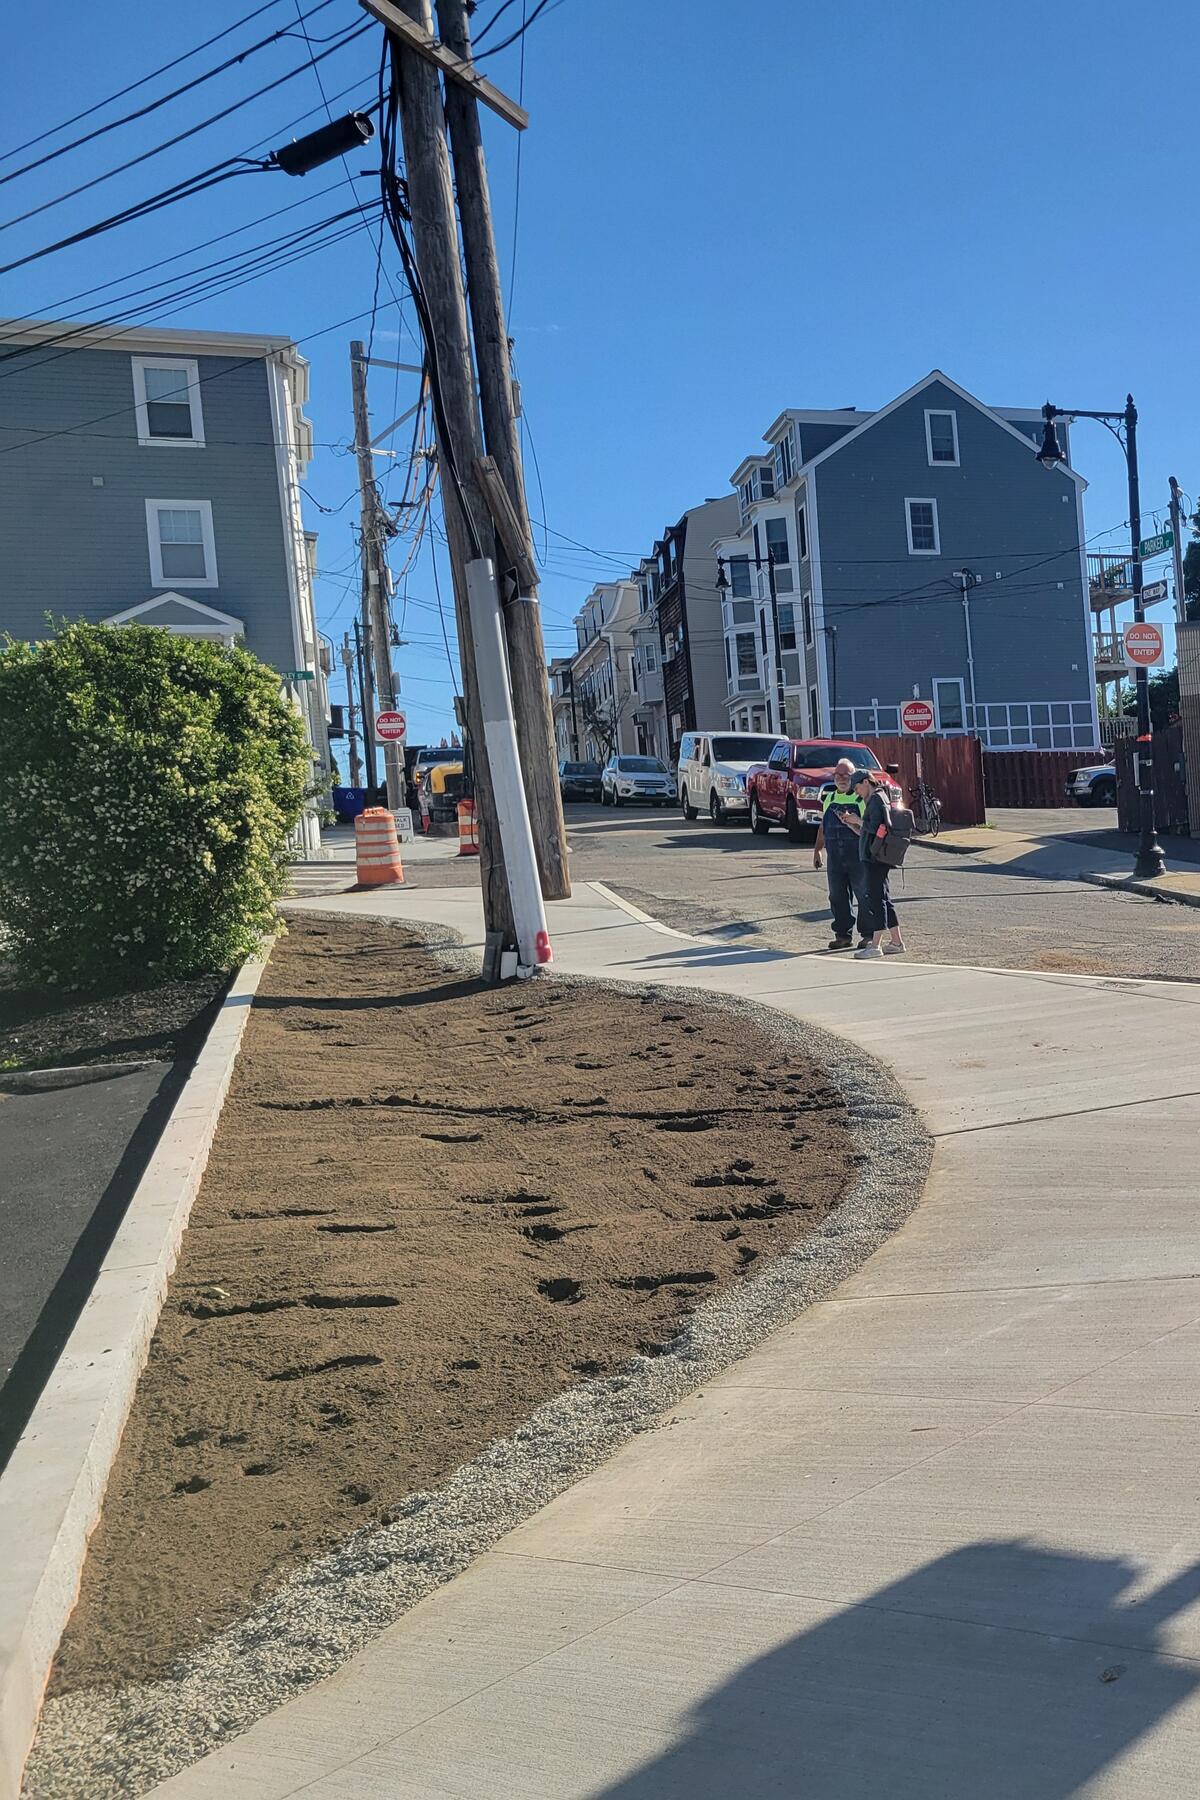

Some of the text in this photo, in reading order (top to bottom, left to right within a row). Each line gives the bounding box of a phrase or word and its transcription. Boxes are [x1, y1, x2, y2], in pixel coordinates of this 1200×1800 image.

[1144, 536, 1165, 554] PARKER
[1130, 632, 1157, 640] DO NOT
